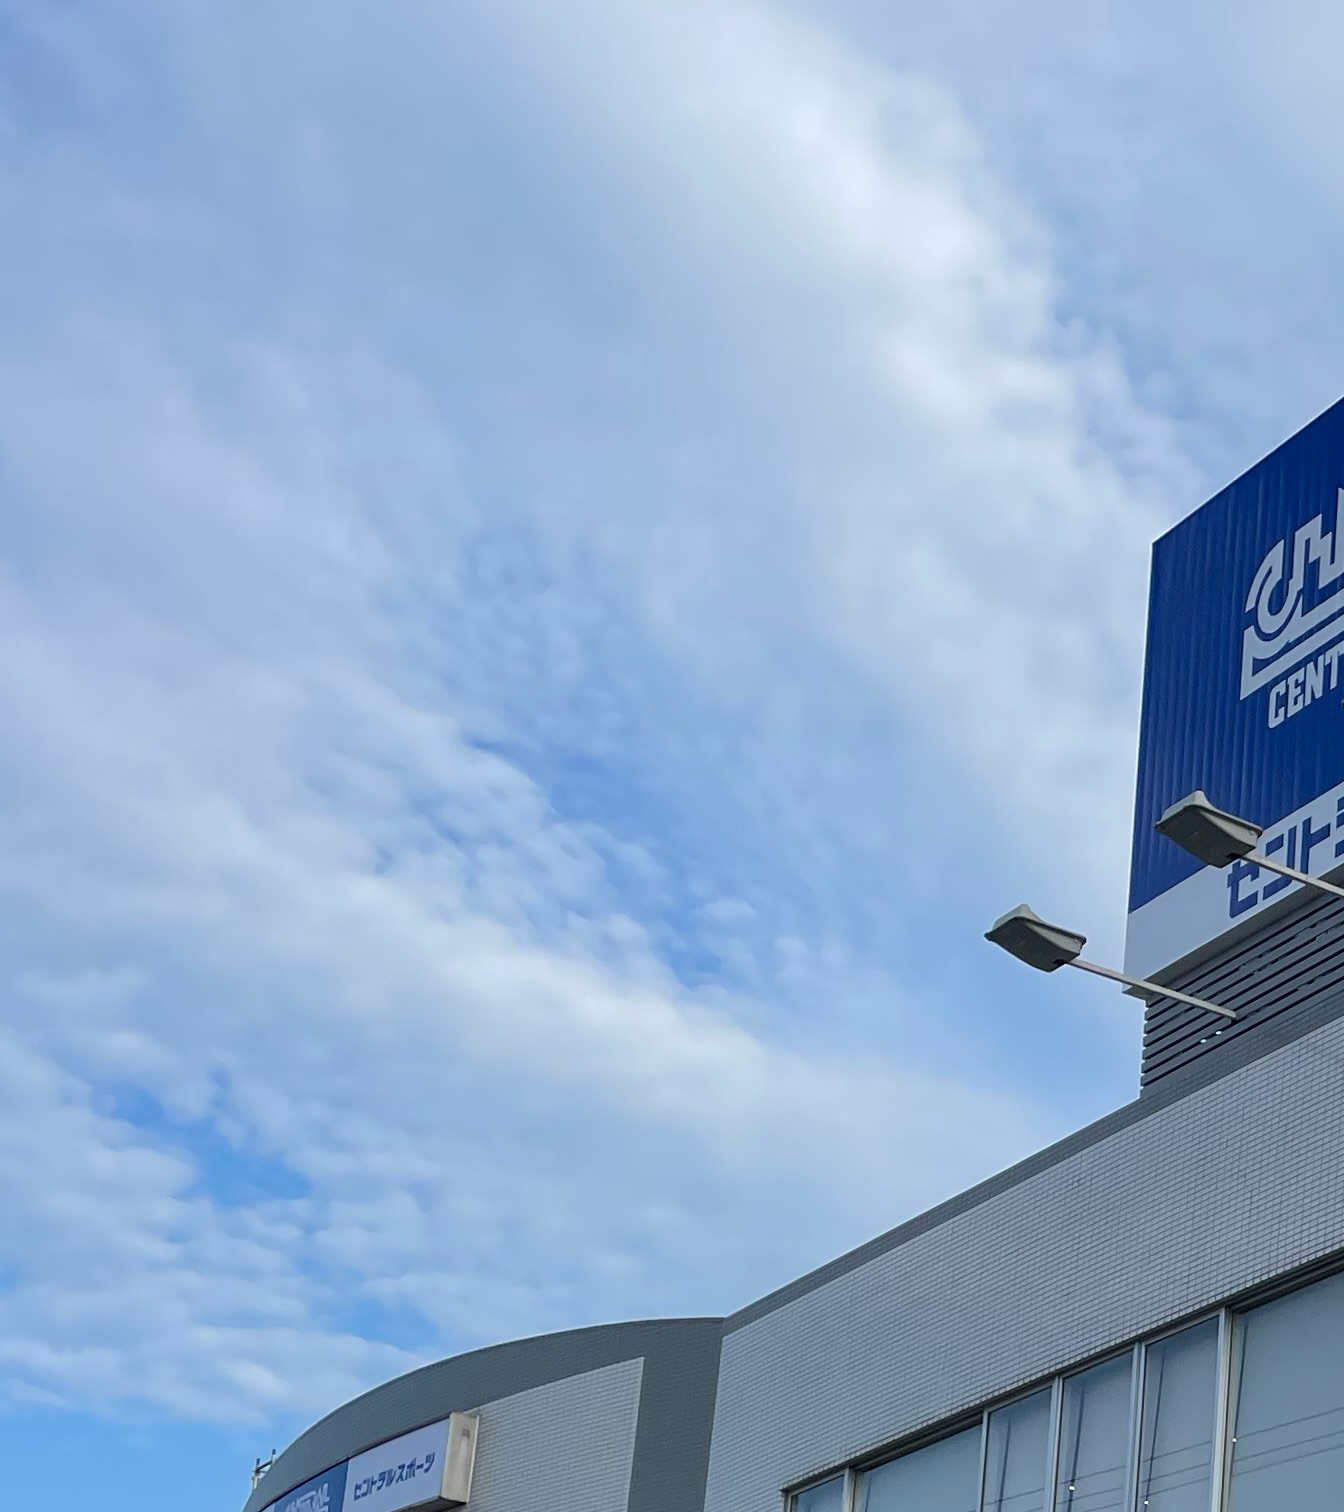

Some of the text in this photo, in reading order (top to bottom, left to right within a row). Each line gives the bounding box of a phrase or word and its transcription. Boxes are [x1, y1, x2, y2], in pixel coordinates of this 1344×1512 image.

[353, 1452, 436, 1501] セントラルスポーツ
